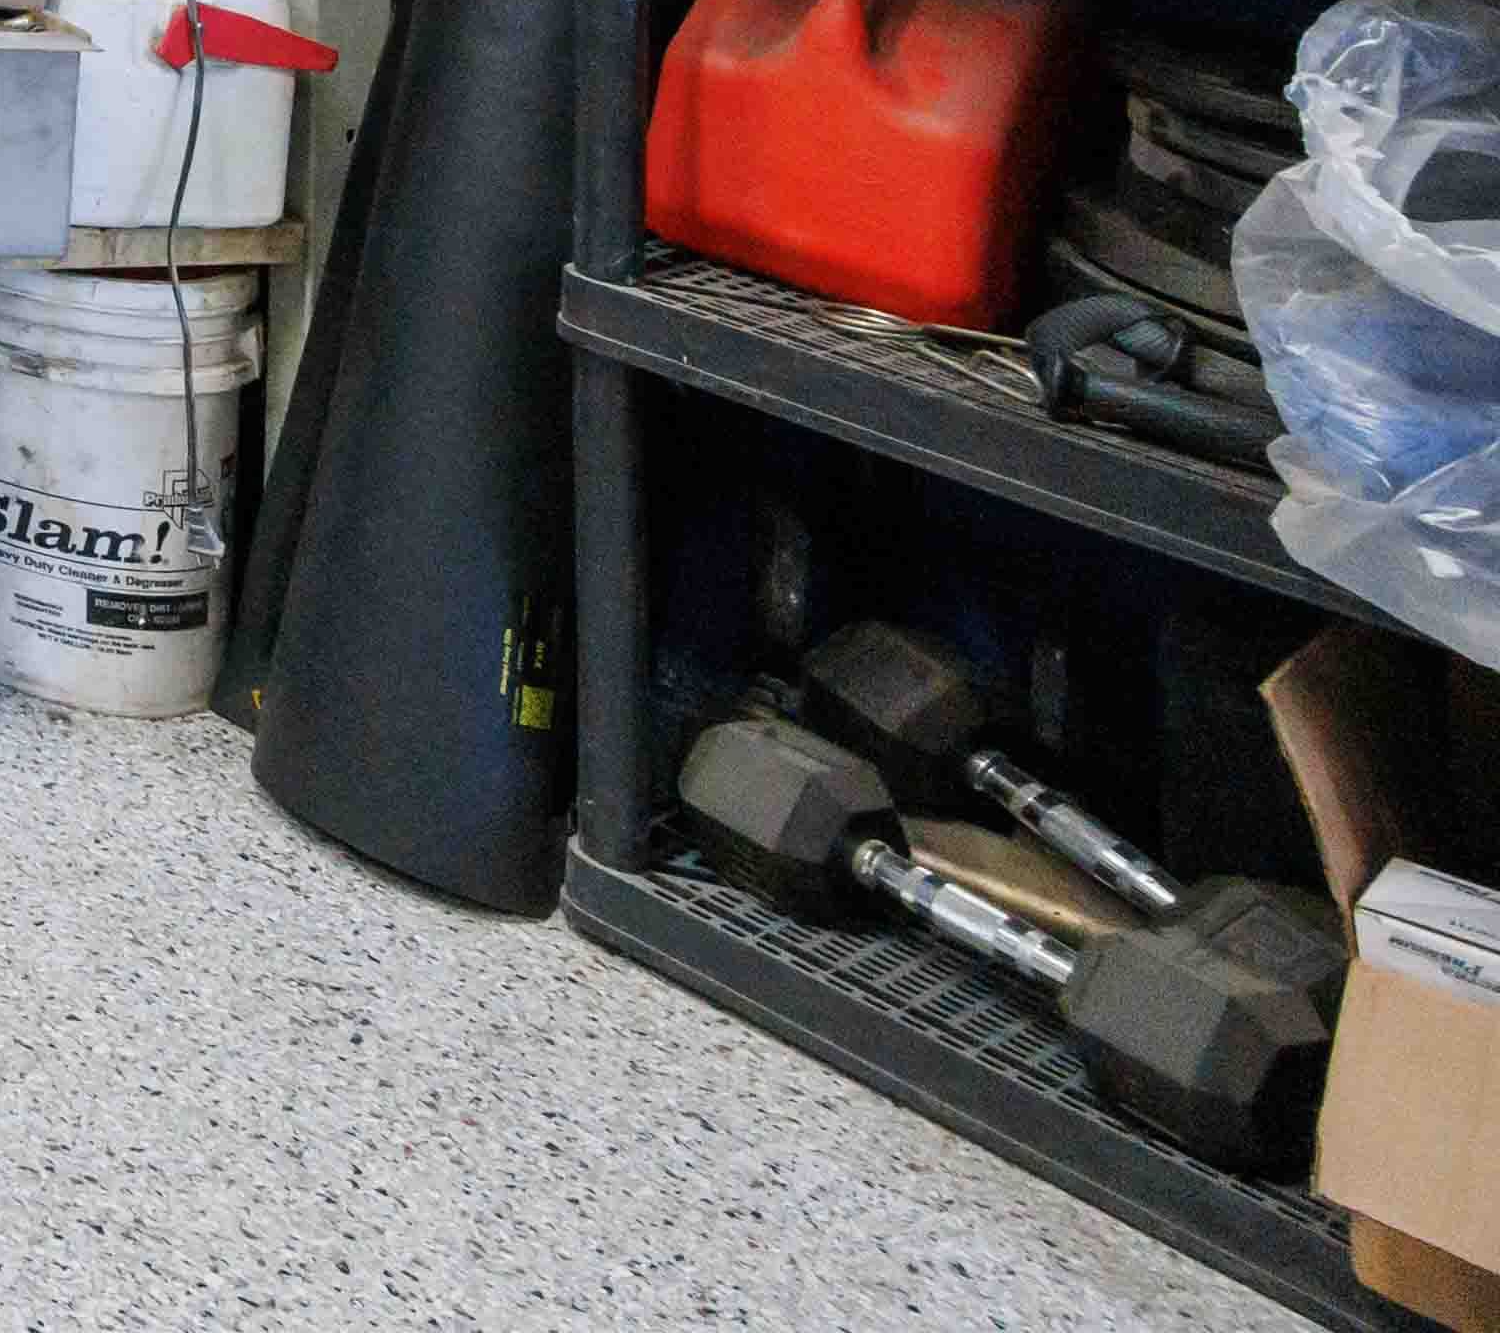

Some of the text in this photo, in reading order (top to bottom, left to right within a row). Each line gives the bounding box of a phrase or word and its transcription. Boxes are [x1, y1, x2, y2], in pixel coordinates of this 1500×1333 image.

[24, 555, 55, 574] Duty
[58, 563, 109, 584] Cleaner
[125, 574, 184, 590] Degreaser
